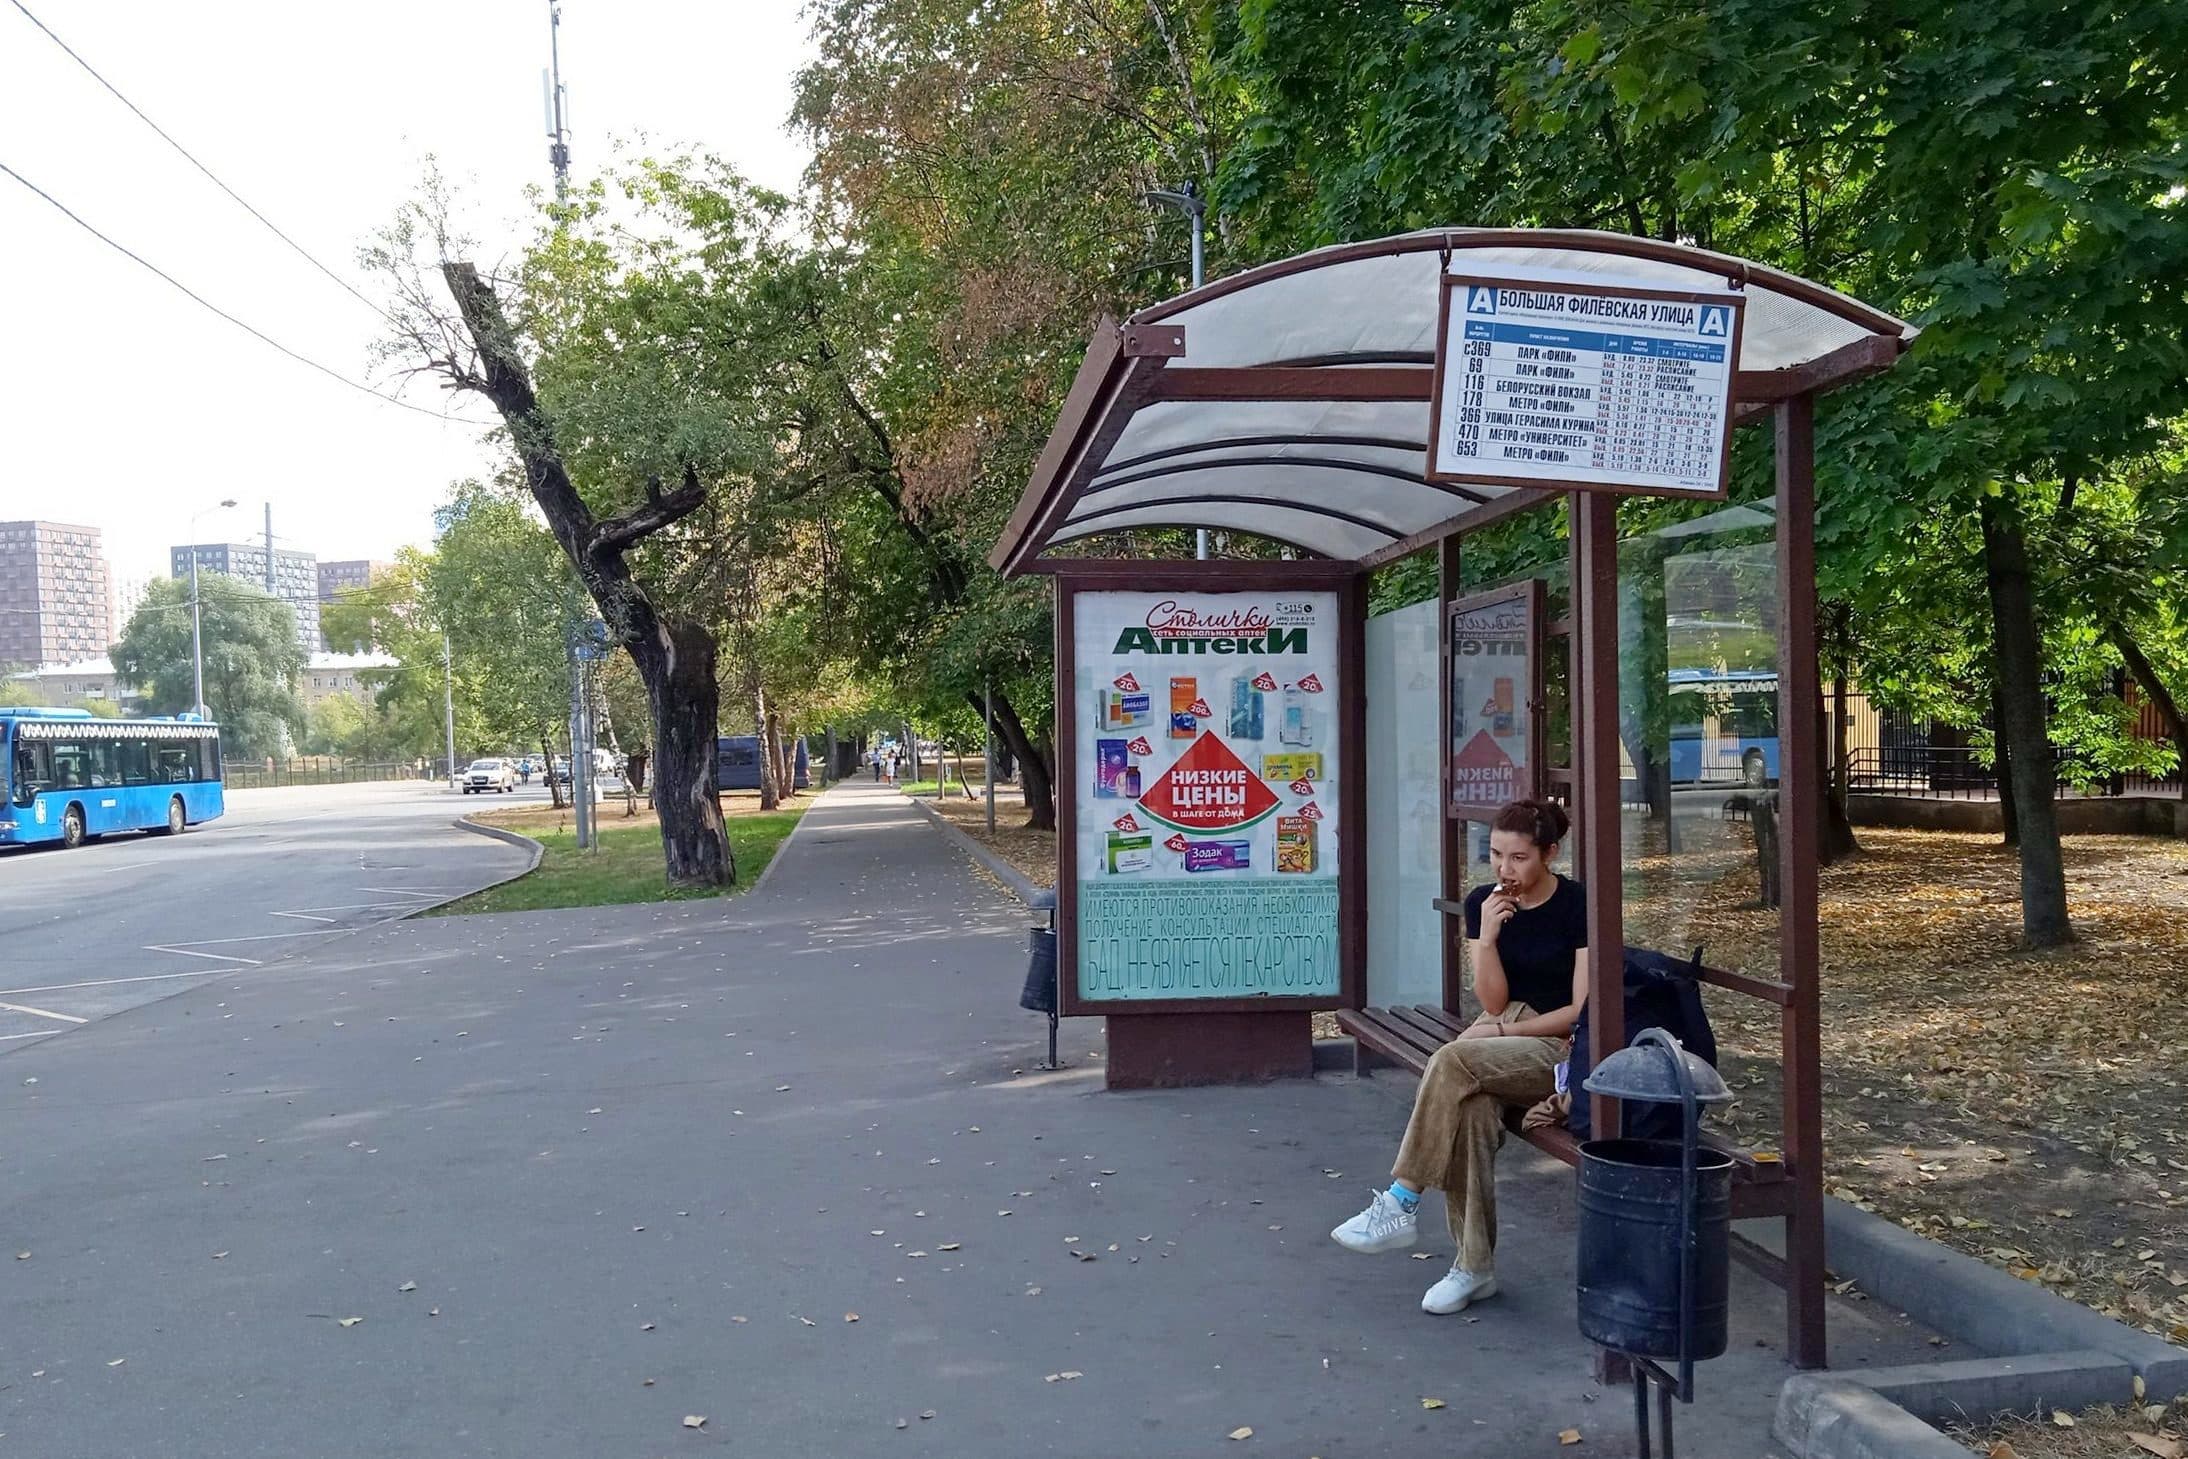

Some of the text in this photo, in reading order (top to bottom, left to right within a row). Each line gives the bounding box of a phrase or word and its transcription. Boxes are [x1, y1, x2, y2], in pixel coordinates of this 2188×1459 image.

[1499, 290, 1564, 311] БОЛЬШАЯ
[1567, 293, 1647, 320] ФИЛЁВСКАЯ
[1649, 304, 1694, 326] УЛИЦА
[1464, 340, 1576, 363] с369 ПАРК «ФИЛИ»
[1468, 358, 1574, 379] 69 ПАРК «ФИЛИ»
[1656, 365, 1696, 376] РАСПИСАНИЕ
[1657, 358, 1690, 367] СМОТРИТЕ
[1464, 374, 1591, 399] 116 БЕЛОРУССКИЙ ВОКЗАЛ
[1654, 382, 1694, 392] РАСПИСАНИЕ
[1655, 374, 1688, 384] СМОТРИТЕ
[1462, 391, 1574, 413] 178 МЕТРО «ФИЛИ»
[1460, 407, 1595, 432] 366 УЛИЦА ГЕРАСИМА КУРИНА
[1458, 424, 1587, 447] 470 МЕТРО «УНИВЕРСИТЕТ»
[1456, 440, 1569, 462] 653 МЕТРО «ФИЛИ»
[1146, 601, 1275, 629] Столички
[1175, 630, 1235, 638] социальных
[1171, 770, 1247, 784] НИЗКИЕ
[1172, 786, 1246, 808] ЦЕНЫ
[1218, 809, 1245, 818] ДОМА
[1192, 848, 1223, 858] Зодак
[1086, 899, 1138, 917] ИМЕЮТСЯ
[1264, 896, 1336, 914] НЕОБХОДИМО
[1086, 918, 1152, 938] ПОЛУЧЕНИЕ
[1160, 917, 1249, 936] КОНСУЛЬТАЦИИ
[1128, 939, 1148, 990] НЕ
[1151, 937, 1230, 990] ЯВЛЯЕТСЯ
[1234, 935, 1337, 988] ЛЕКАРСТВОМ
